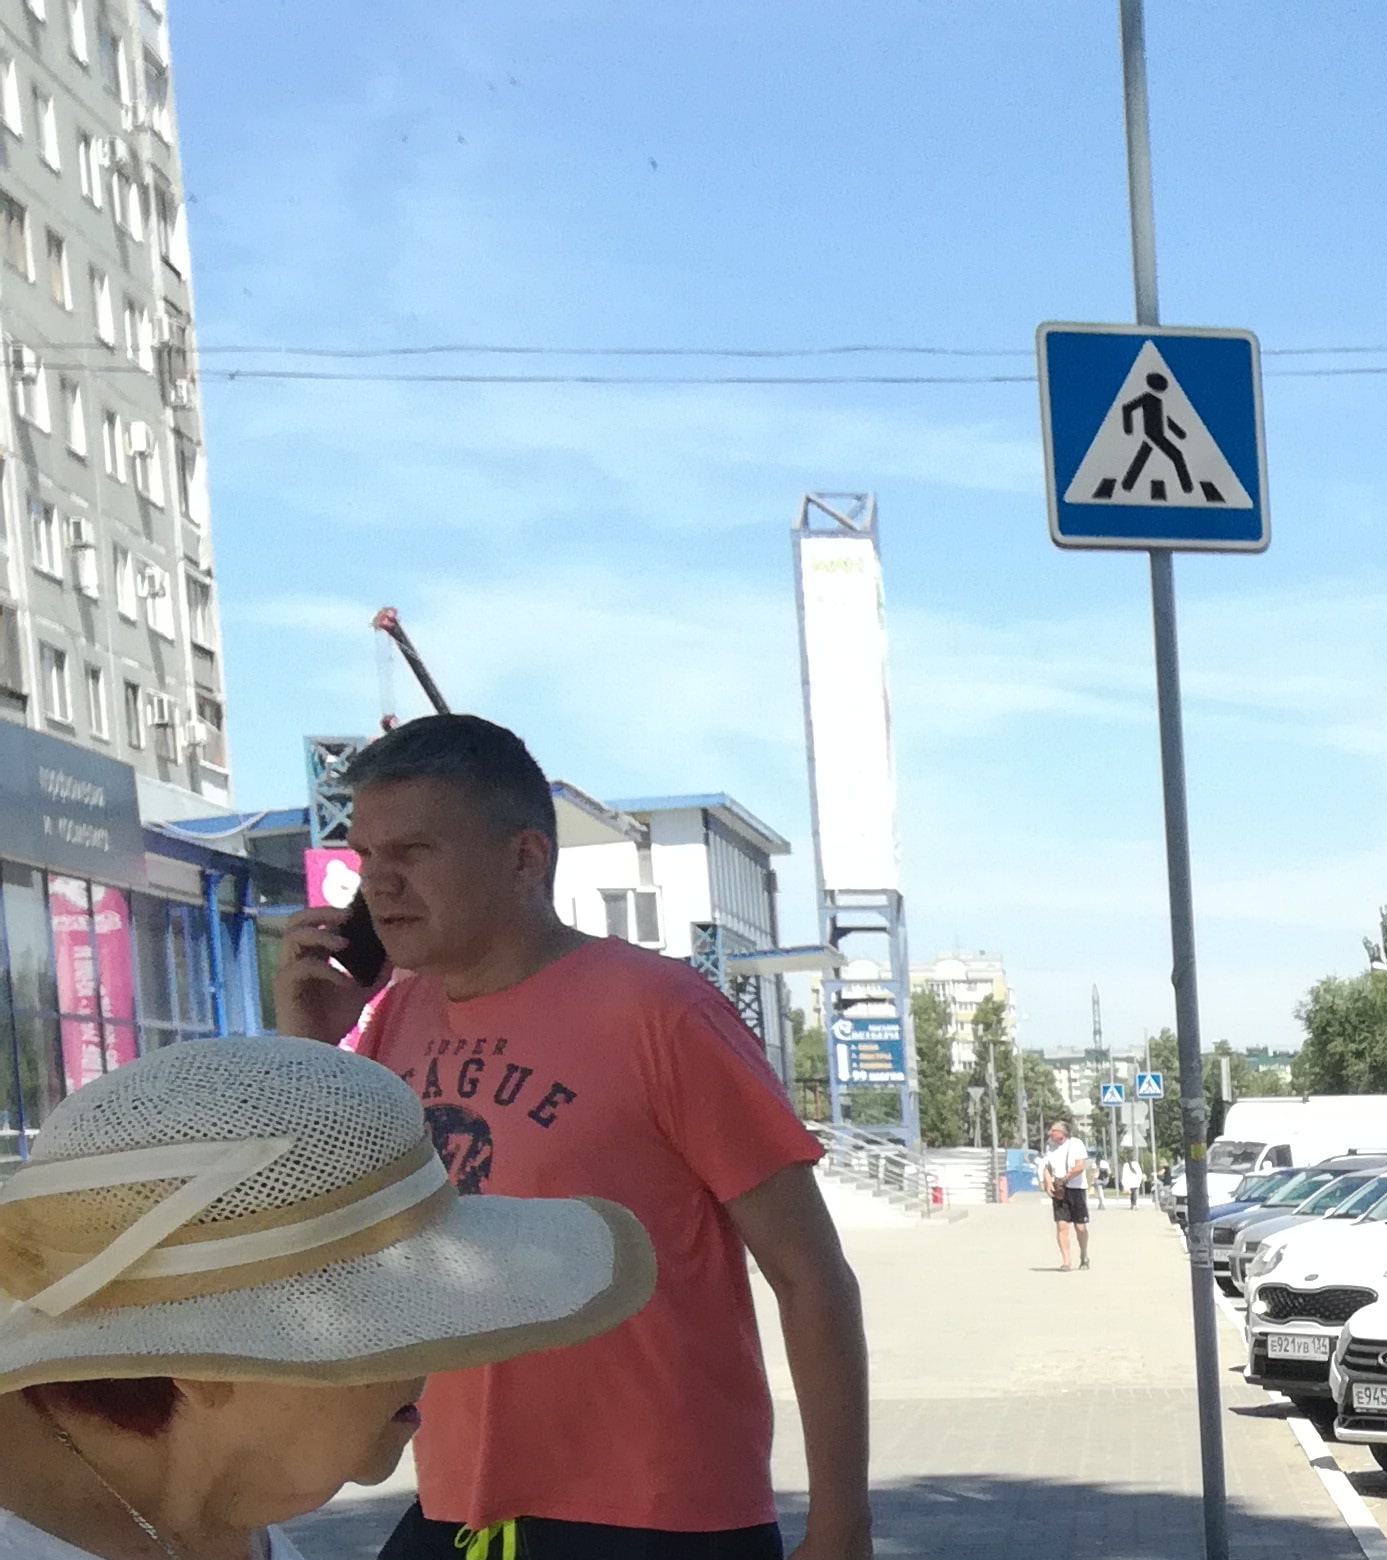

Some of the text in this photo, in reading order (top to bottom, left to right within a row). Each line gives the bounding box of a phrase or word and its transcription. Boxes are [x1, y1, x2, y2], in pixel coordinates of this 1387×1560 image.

[424, 1038, 508, 1056] SUPER
[401, 1057, 577, 1128] AGUE
[1312, 1337, 1327, 1351] 134
